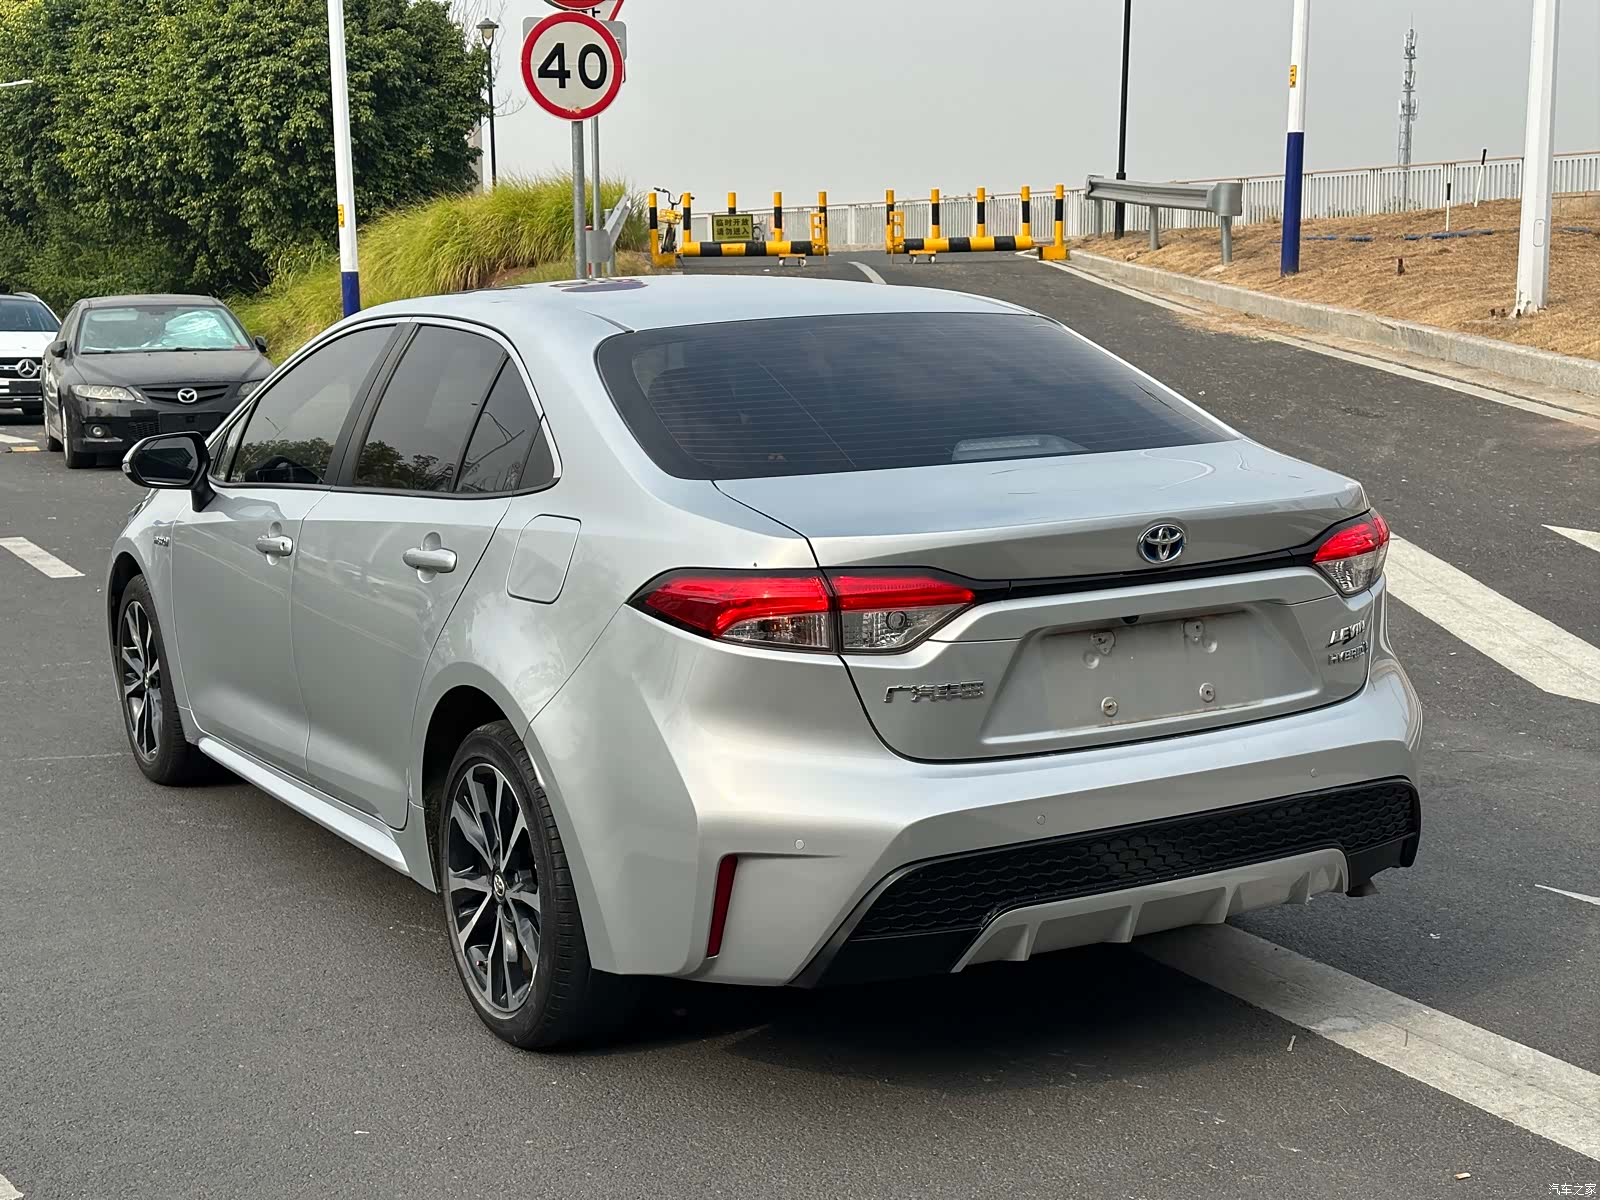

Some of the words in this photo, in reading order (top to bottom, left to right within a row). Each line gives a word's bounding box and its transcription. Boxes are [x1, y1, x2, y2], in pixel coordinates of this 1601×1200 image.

[537, 42, 608, 90] 40
[715, 218, 749, 226] 临时开放
[716, 227, 749, 235] 请勿进入
[1329, 619, 1365, 644] LEVIN
[883, 681, 984, 702] 广汽丰田
